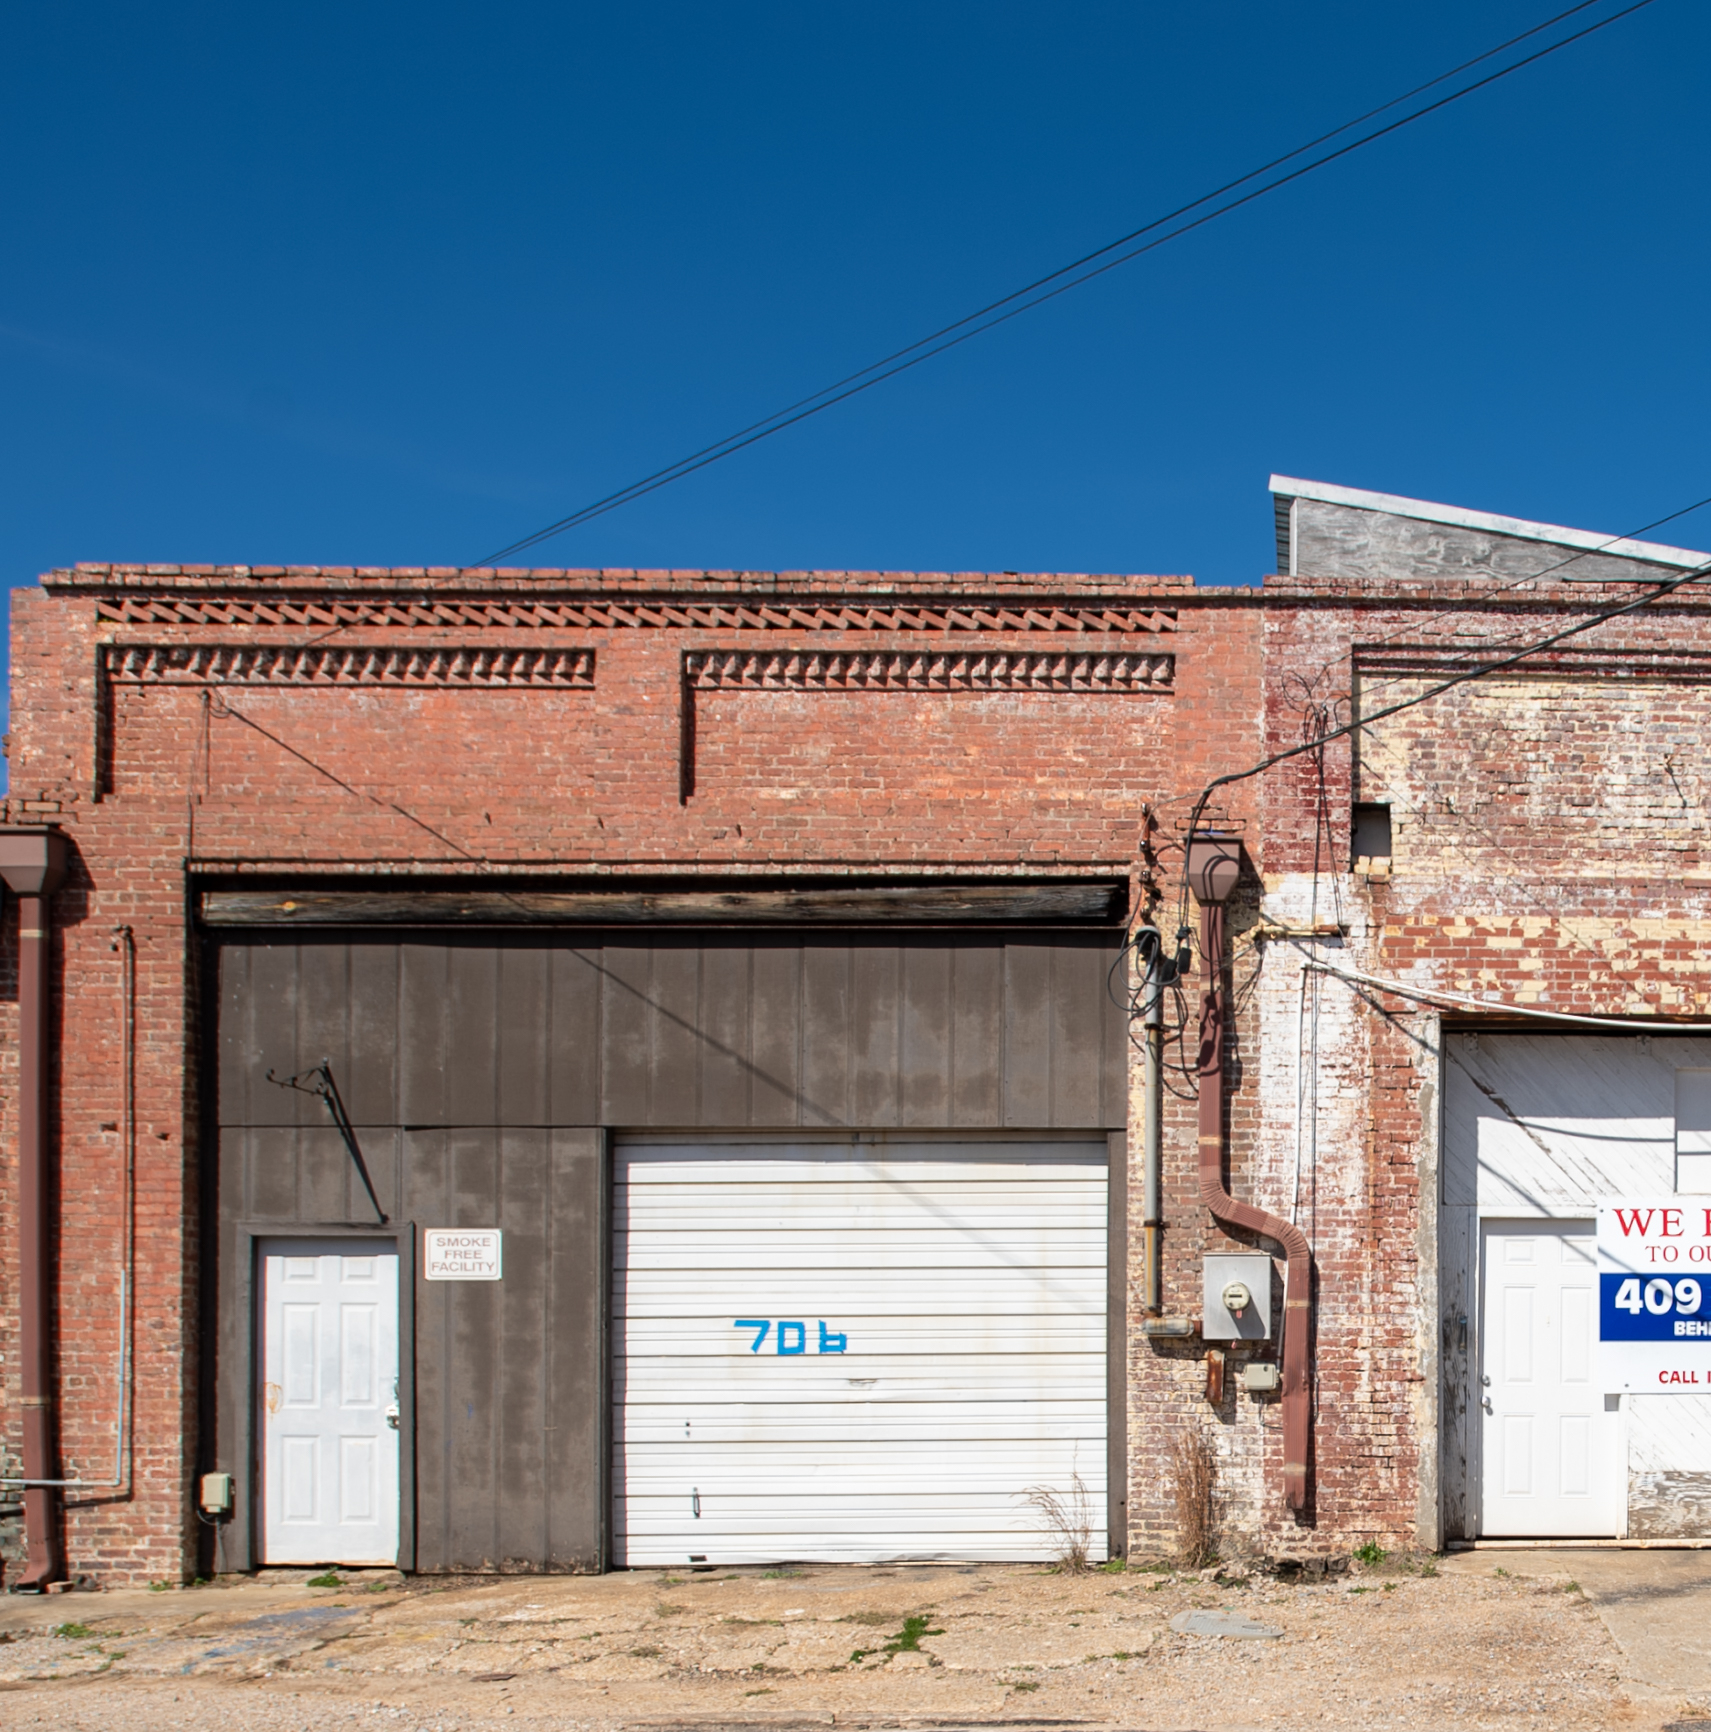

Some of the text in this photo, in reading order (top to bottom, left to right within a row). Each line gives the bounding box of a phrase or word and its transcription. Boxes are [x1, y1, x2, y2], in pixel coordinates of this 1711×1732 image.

[1613, 1208, 1684, 1238] WE
[436, 1237, 491, 1247] SMOKE
[444, 1250, 482, 1260] FREE
[1645, 1246, 1679, 1262] TO
[431, 1261, 495, 1272] FACILITY
[1615, 1278, 1702, 1315] 409
[1658, 1370, 1699, 1385] CALL
